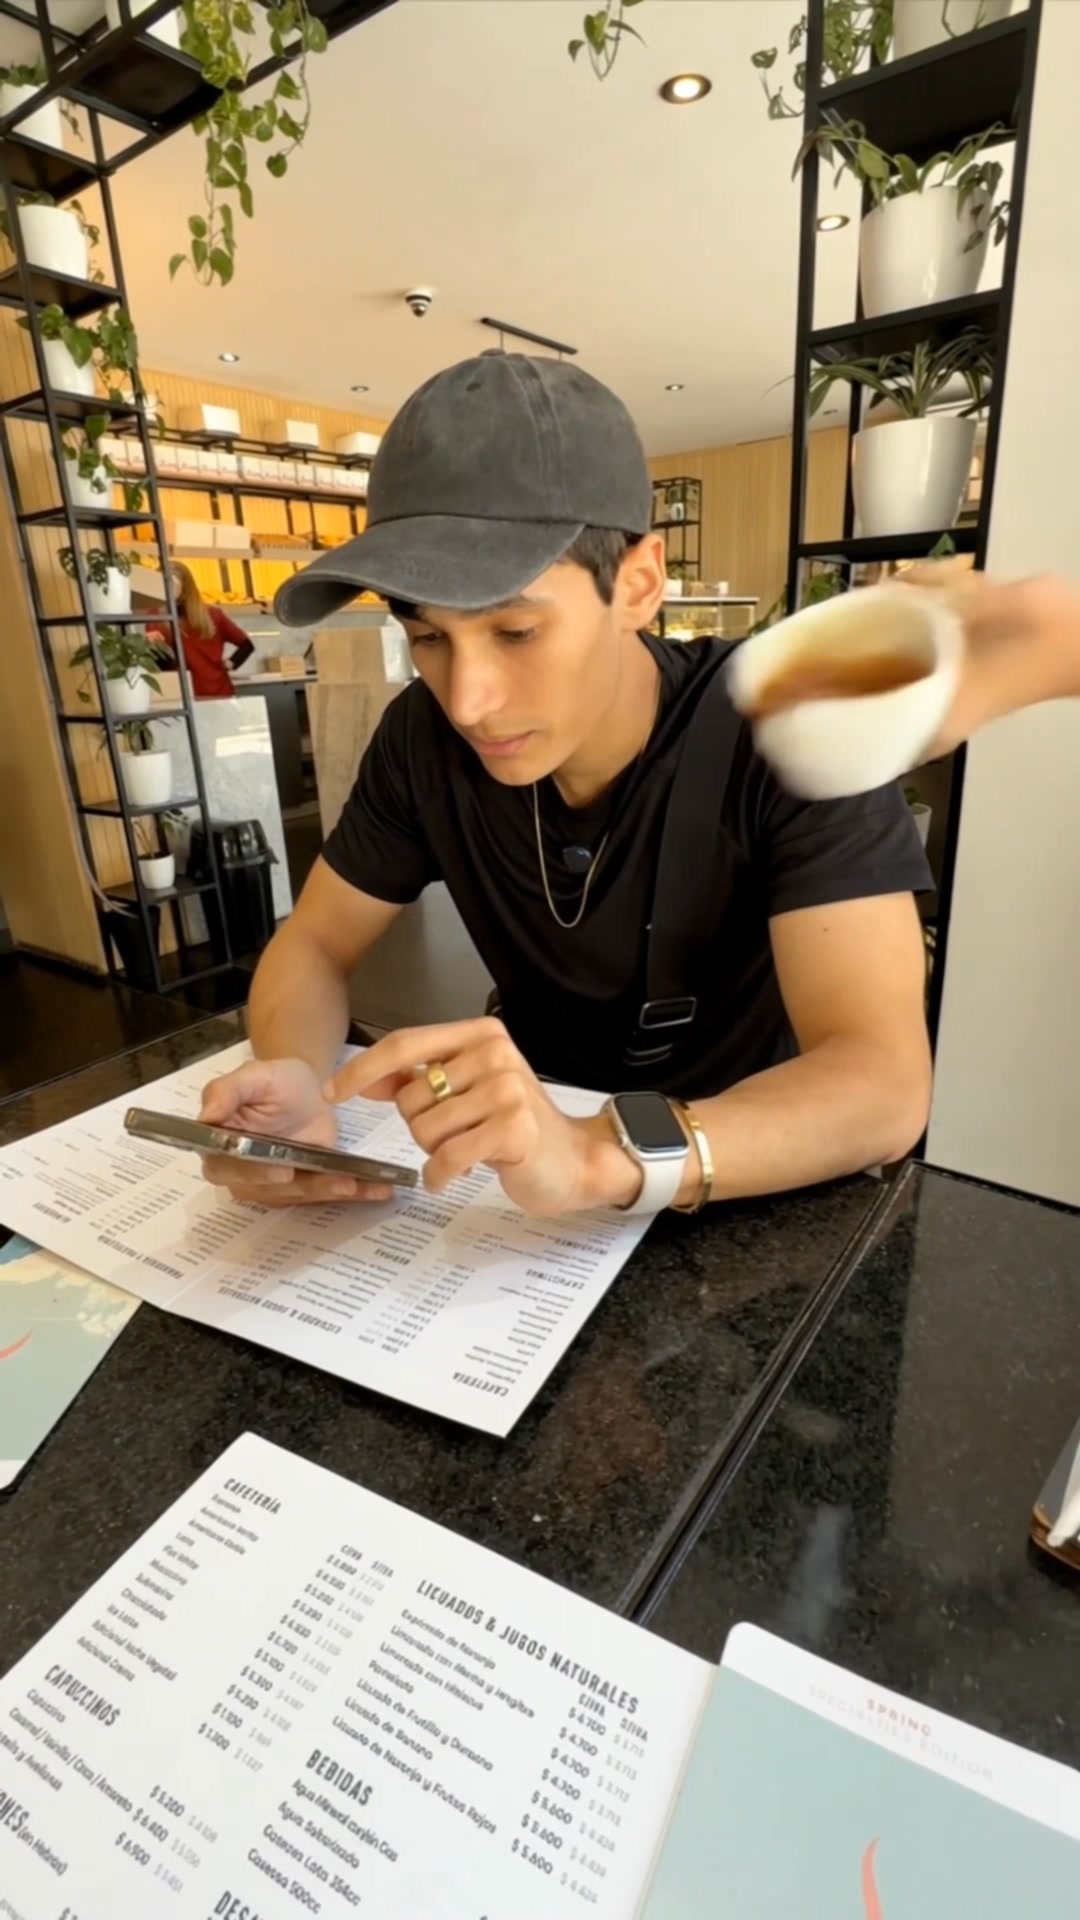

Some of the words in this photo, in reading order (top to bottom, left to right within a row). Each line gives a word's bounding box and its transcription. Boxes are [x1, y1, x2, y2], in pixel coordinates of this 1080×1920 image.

[223, 1478, 281, 1514] CAFETERÍA
[416, 1579, 484, 1624] LICUADOS
[484, 1616, 496, 1632] &
[498, 1625, 547, 1661] JUGOS
[549, 1651, 638, 1714] NATURALES
[44, 1664, 120, 1726] CAPUCCINOS
[865, 1698, 933, 1737] SPRING
[305, 1748, 373, 1806] BEBIDAS
[559, 1753, 590, 1778] 4.700
[540, 1796, 573, 1824] 5.600
[530, 1820, 563, 1849] 5.600
[520, 1844, 553, 1874] 5.600
[288, 1880, 321, 1914] 500cc
